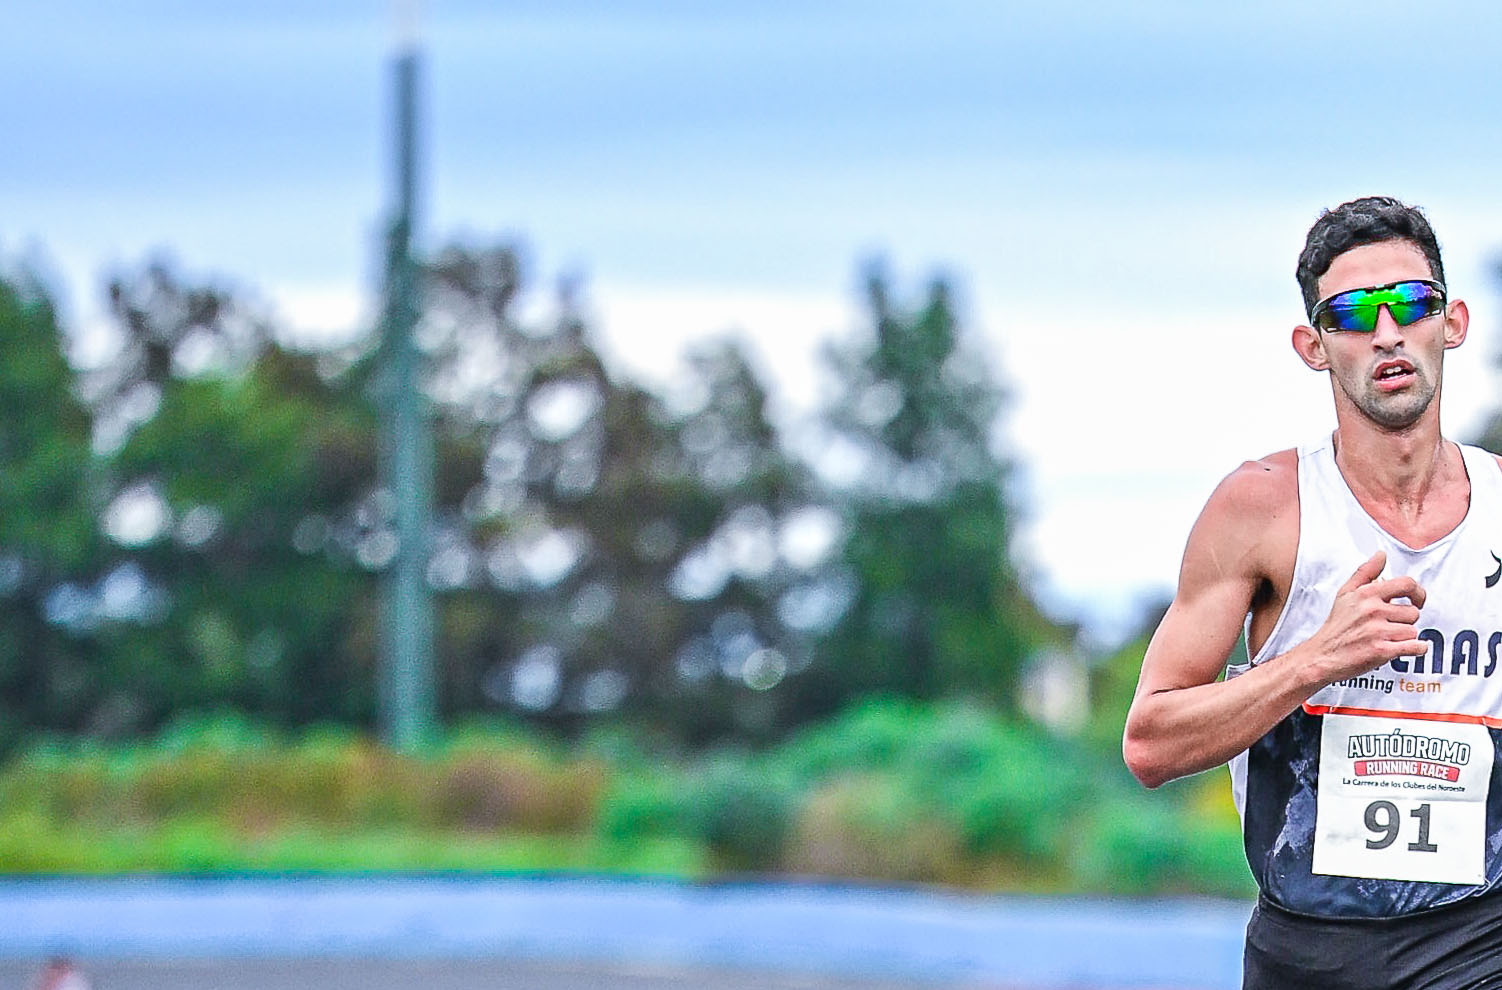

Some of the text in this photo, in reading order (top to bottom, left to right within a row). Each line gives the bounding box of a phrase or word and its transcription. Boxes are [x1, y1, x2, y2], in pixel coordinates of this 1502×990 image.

[1399, 678, 1441, 693] team
[1347, 728, 1471, 766] AUTÓDROMO
[1366, 761, 1449, 779] RUNNING RACE
[1352, 779, 1379, 787] Carrera
[1391, 780, 1401, 788] los
[1402, 781, 1426, 790] Clubes
[1363, 800, 1438, 853] 91
